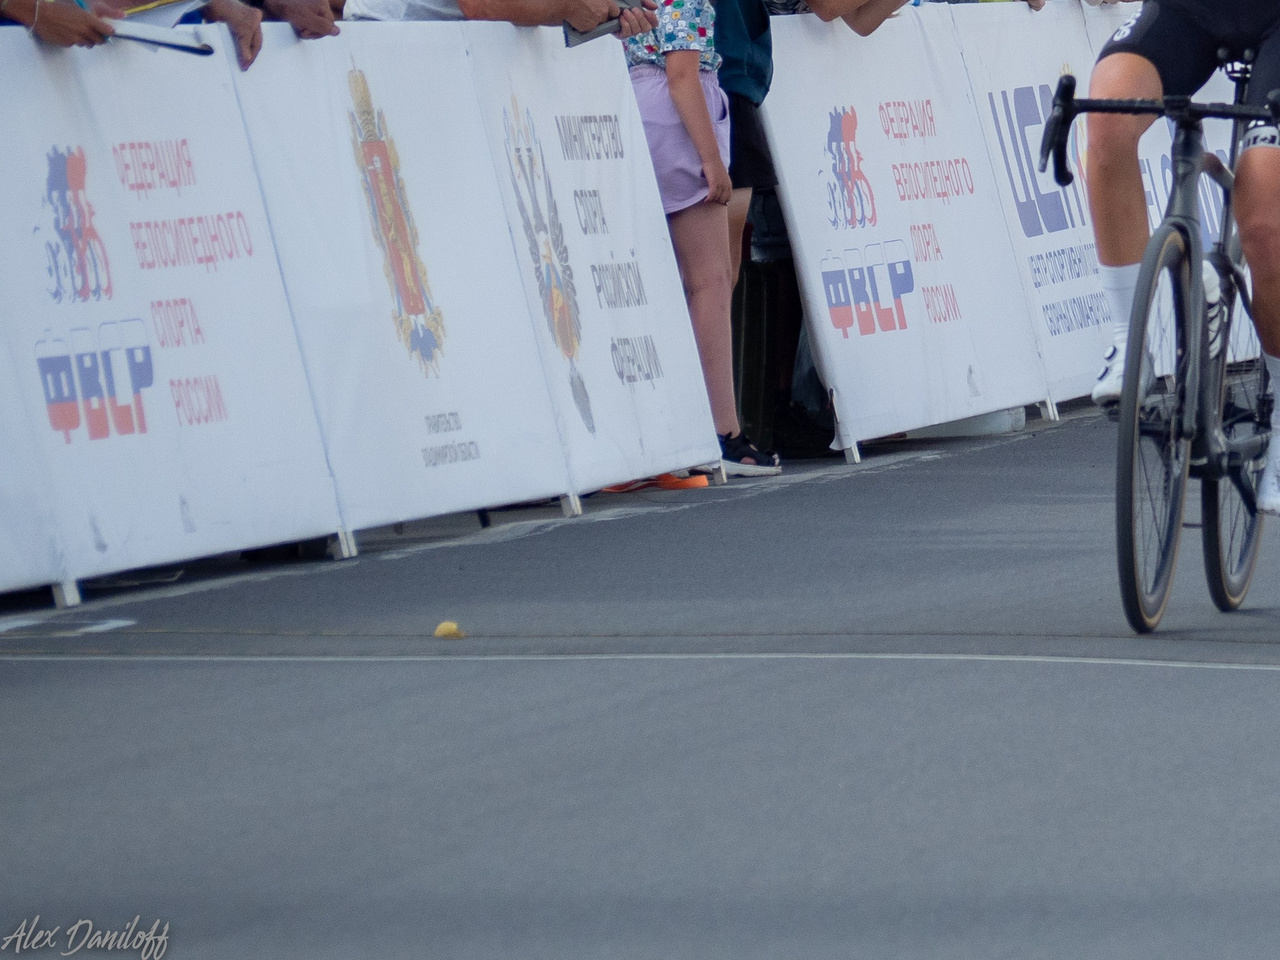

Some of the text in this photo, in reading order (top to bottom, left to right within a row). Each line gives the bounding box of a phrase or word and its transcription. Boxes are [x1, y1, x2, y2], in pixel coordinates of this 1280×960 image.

[878, 99, 937, 146] ФЕДЕРАЦИЯ
[112, 138, 197, 200] ФЕДЕРАЦИЯ
[891, 157, 974, 206] ВЕЛОСИПЕДНОГО
[129, 210, 253, 274] ВЕЛОСИПЕДНОГО
[922, 283, 963, 324] РОССИИ
